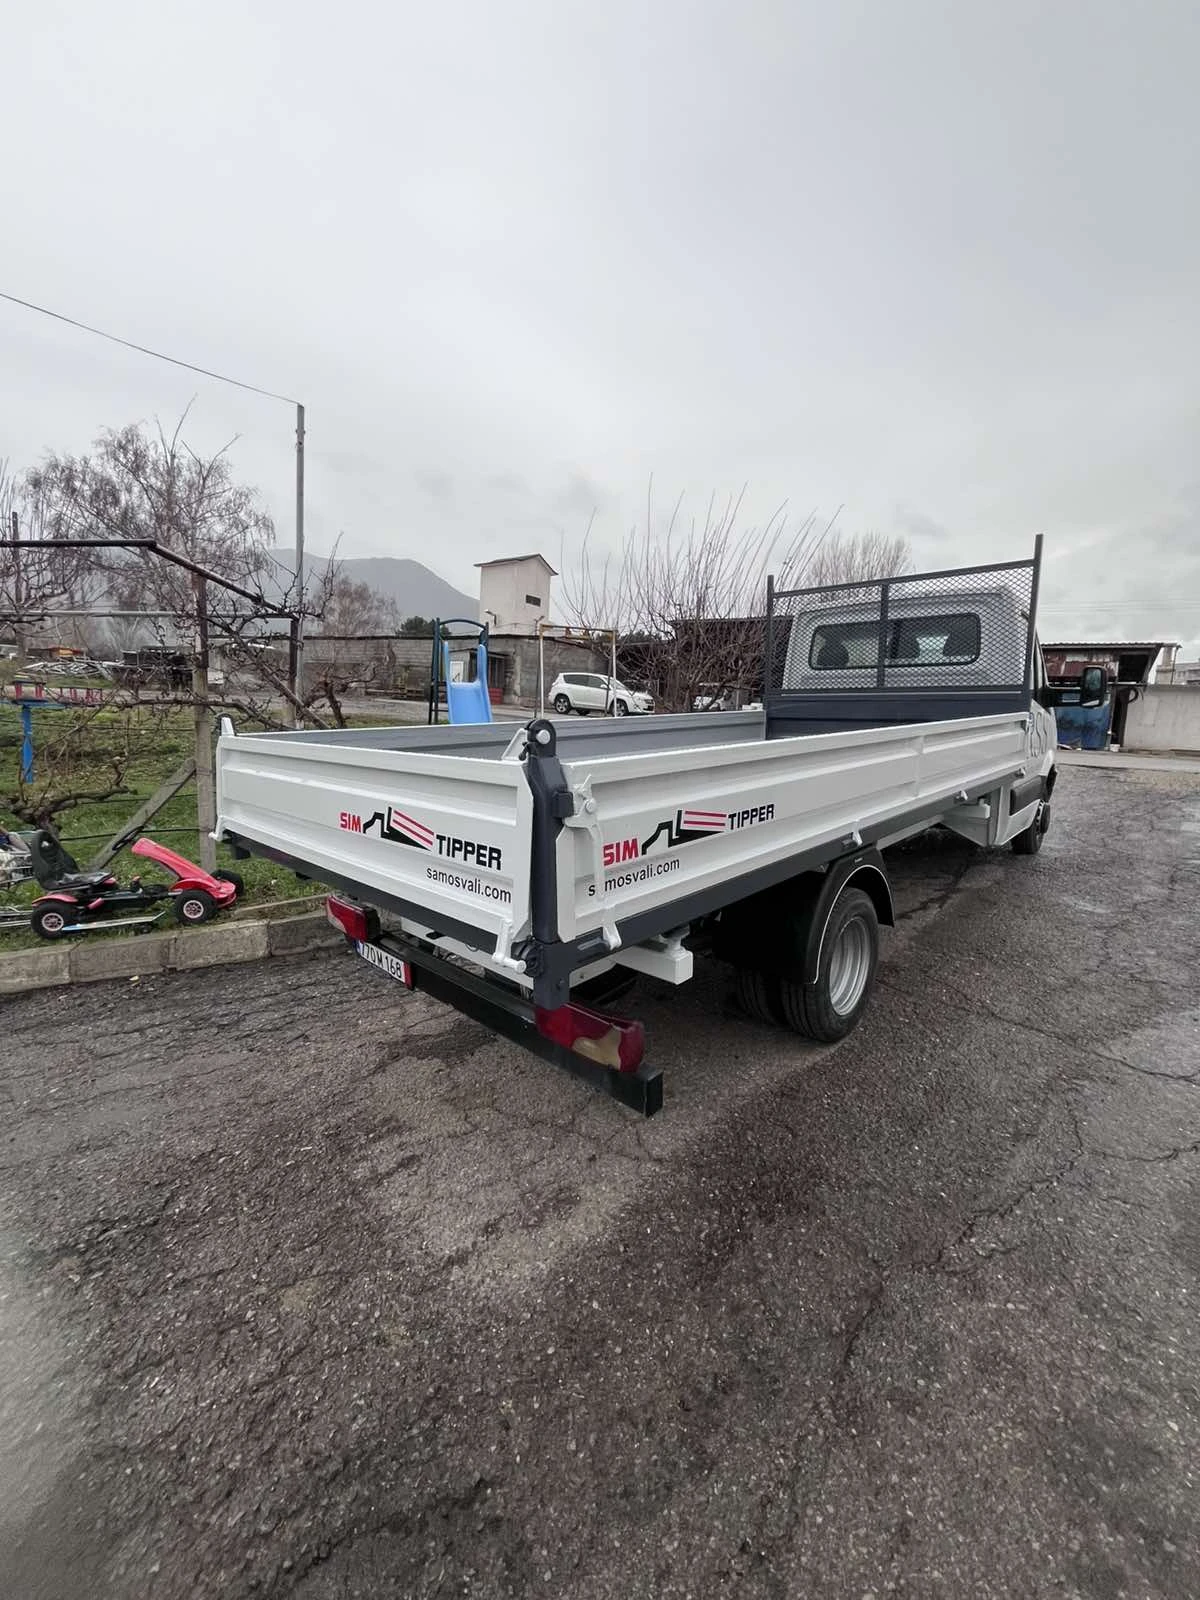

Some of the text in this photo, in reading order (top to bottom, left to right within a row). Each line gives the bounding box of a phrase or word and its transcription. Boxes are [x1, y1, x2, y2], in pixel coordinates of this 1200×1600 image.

[340, 811, 502, 870] SIM TIPPER
[603, 803, 775, 866] SIM TIPPER
[426, 867, 512, 903] samosvali.com
[588, 858, 680, 896] smosvali.com
